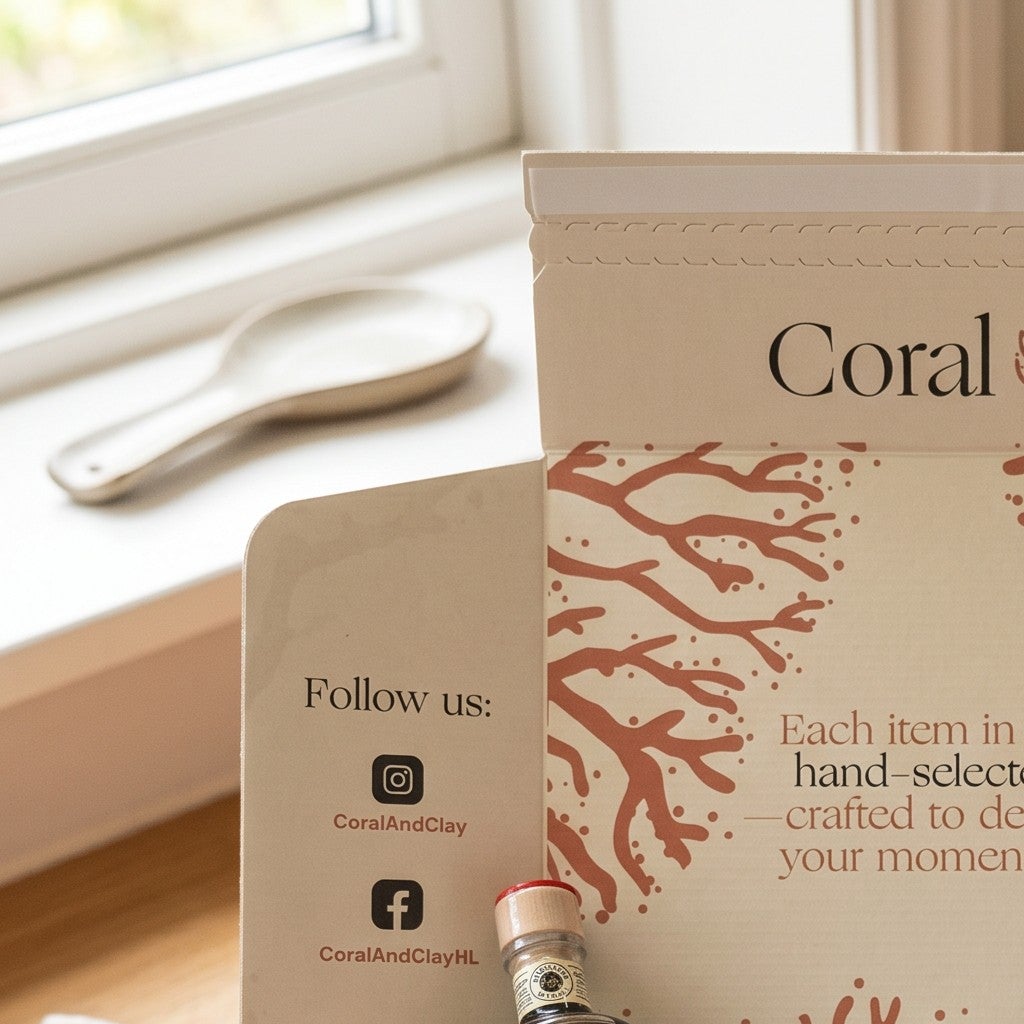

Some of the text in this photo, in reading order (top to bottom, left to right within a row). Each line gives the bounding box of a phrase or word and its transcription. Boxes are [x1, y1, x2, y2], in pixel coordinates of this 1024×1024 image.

[769, 312, 996, 397] Coral
[304, 676, 492, 717] Follow us:
[779, 710, 874, 745] Each
[887, 713, 969, 745] item
[982, 713, 1015, 745] in
[333, 813, 468, 838] CoralAndClay
[929, 799, 965, 831] to
[778, 847, 864, 880] your
[319, 946, 480, 968] CoralAndClayHL
